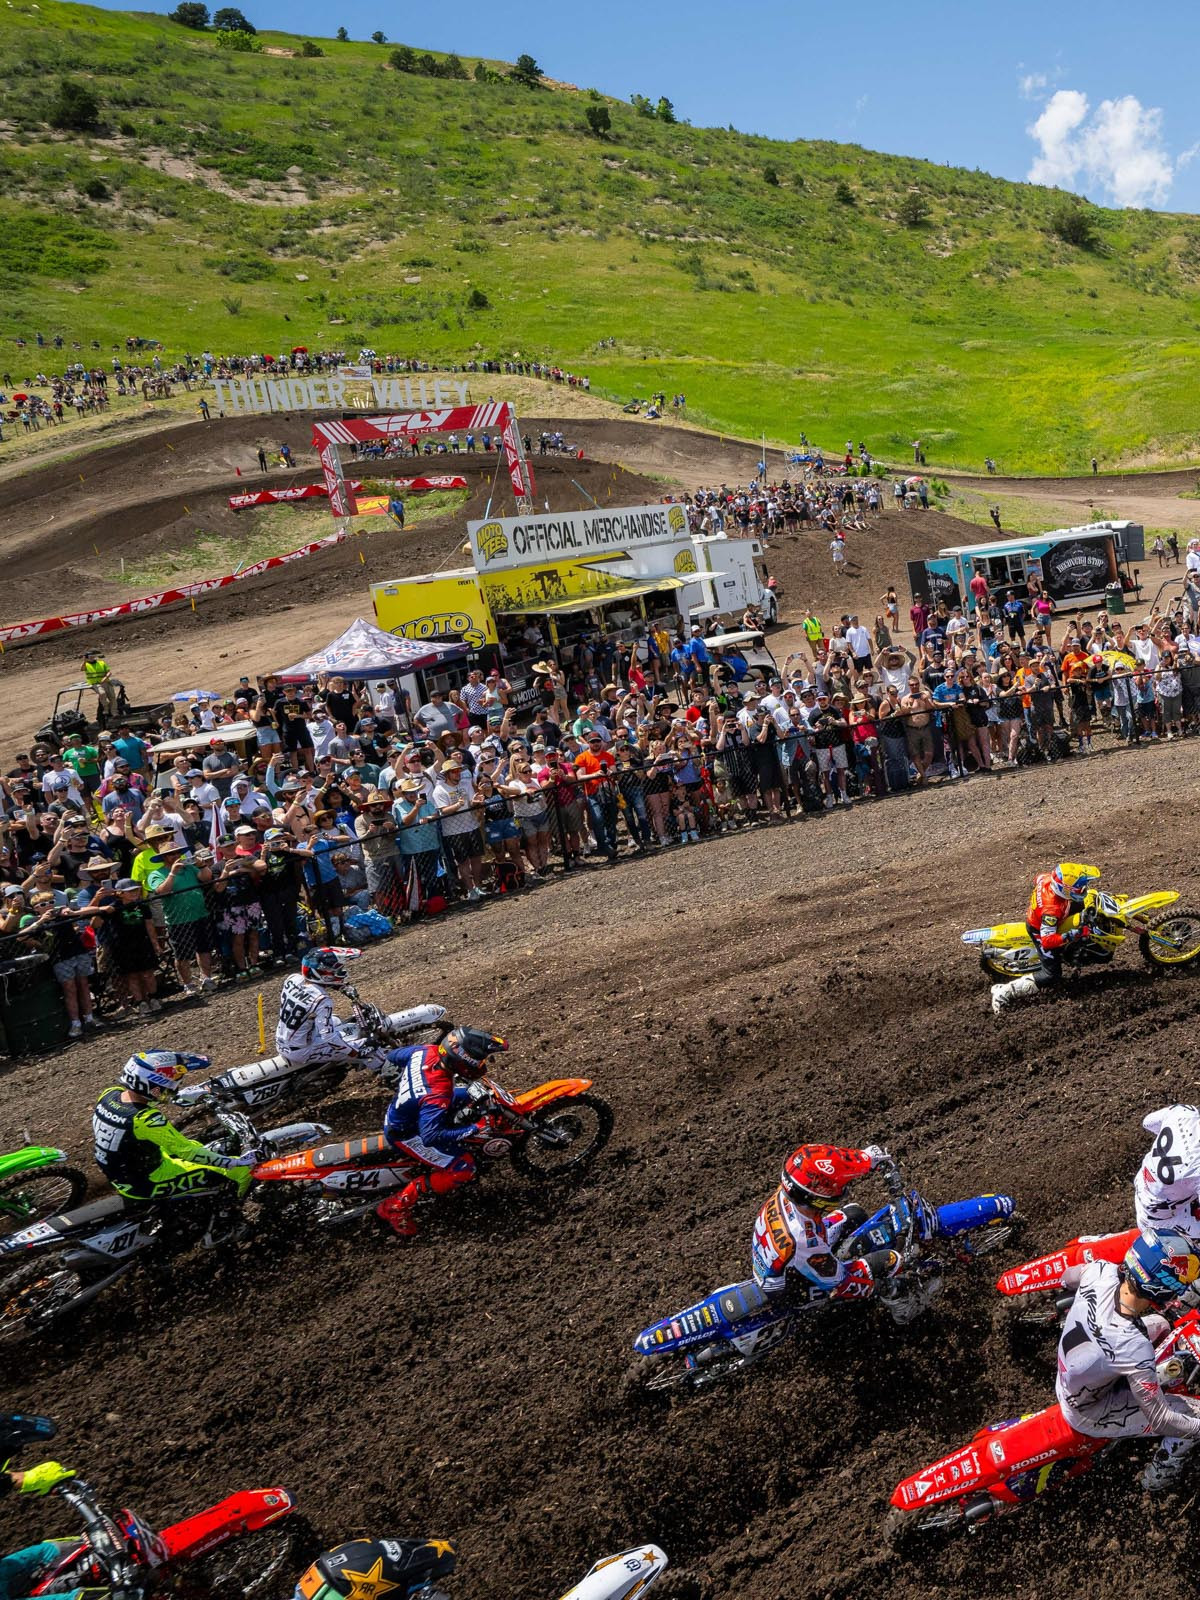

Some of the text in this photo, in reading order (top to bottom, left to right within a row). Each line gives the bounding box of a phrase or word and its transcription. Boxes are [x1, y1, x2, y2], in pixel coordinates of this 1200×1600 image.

[209, 378, 470, 412] THUNDER VALLEY
[365, 409, 454, 433] FLY
[387, 428, 439, 437] RACING
[477, 523, 503, 550] MOTO
[512, 512, 668, 555] OFFICIAL MERCHANDISE
[483, 536, 508, 563] TEES
[1087, 555, 1104, 569] STOP
[130, 594, 165, 612] FLY
[391, 613, 473, 640] MOTO
[1012, 948, 1031, 961] 12
[284, 980, 315, 1005] STINE
[280, 992, 308, 1030] 268
[252, 1083, 282, 1104] 268
[96, 1103, 128, 1125] PURDON
[191, 1154, 232, 1169] FXR
[1152, 1126, 1183, 1186] 96
[151, 1169, 207, 1198] FXR
[345, 1169, 381, 1190] 84
[107, 1229, 139, 1255] 421
[677, 1329, 717, 1348] DUNLOP
[1062, 1320, 1093, 1358] 1
[919, 1446, 973, 1479] DUNLOP
[1010, 1448, 1058, 1473] HONDA
[924, 1477, 979, 1503] DUNLOP
